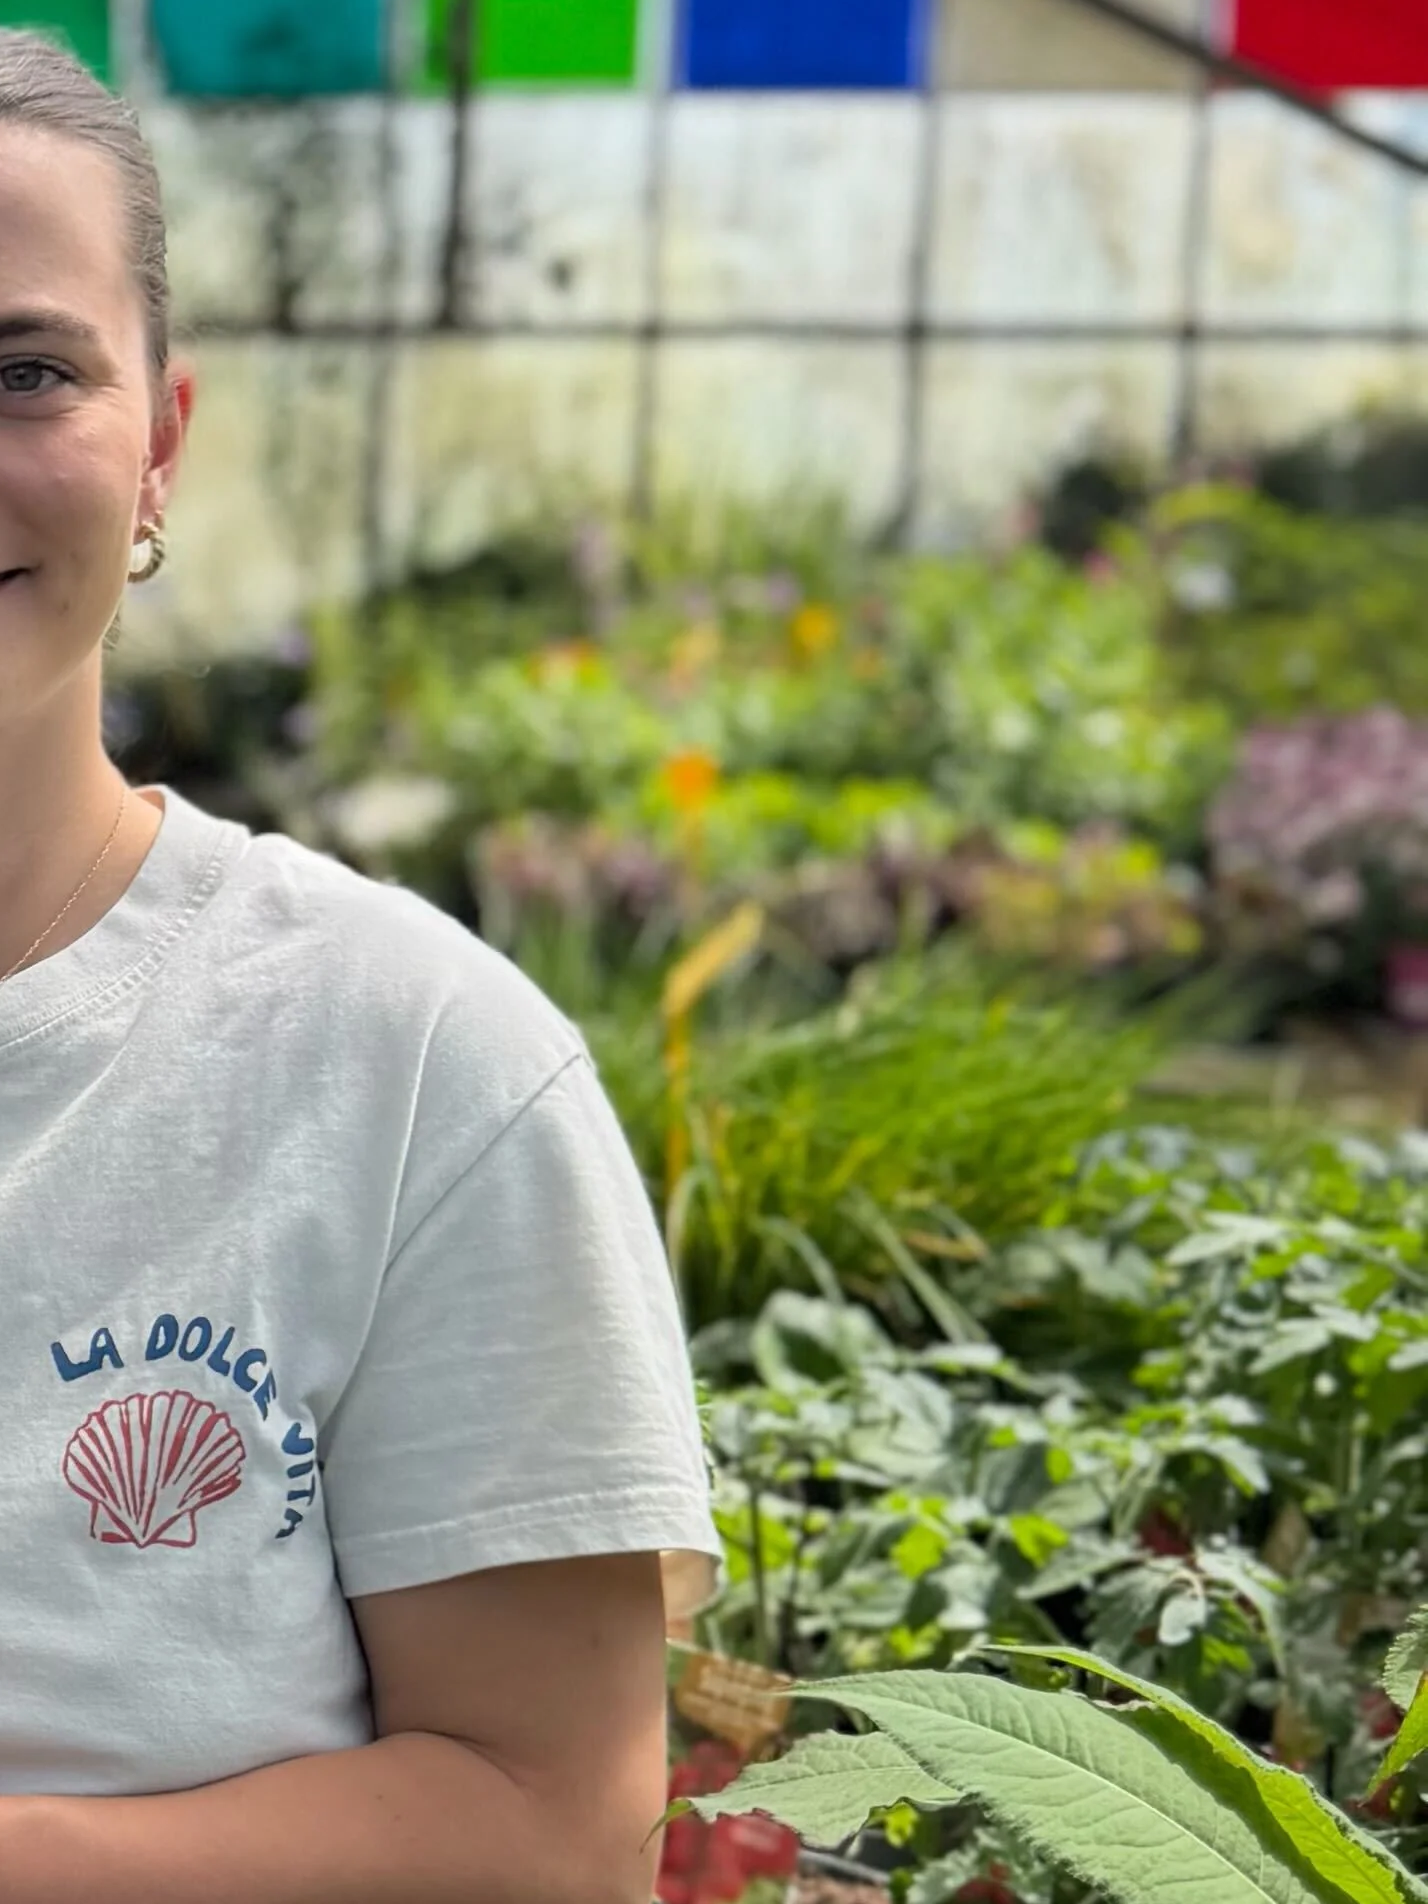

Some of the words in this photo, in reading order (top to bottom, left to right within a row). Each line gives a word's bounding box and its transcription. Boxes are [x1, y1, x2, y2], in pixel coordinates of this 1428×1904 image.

[50, 1327, 124, 1382] LA
[145, 1313, 277, 1421] DOLCE
[275, 1422, 316, 1539] VITA
